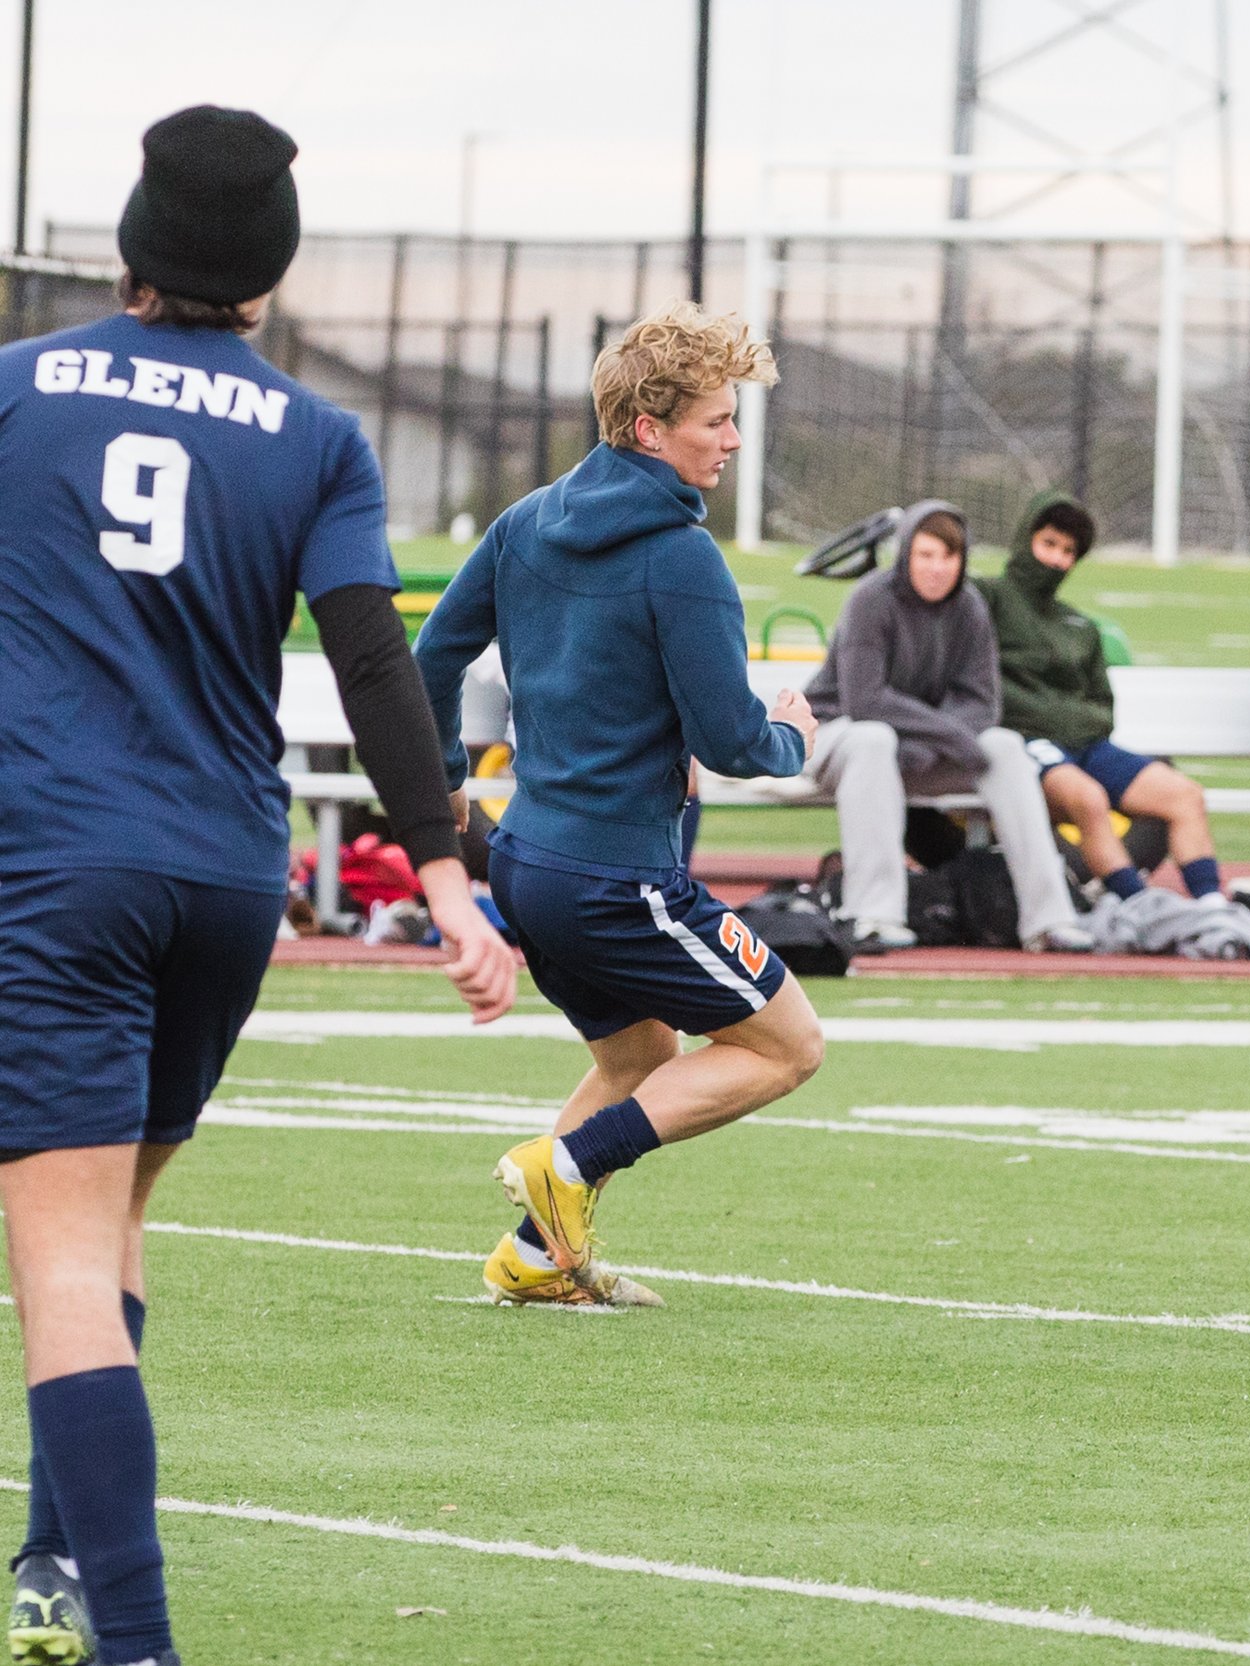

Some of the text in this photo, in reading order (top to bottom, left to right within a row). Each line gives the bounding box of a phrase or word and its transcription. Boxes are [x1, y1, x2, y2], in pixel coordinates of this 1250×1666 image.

[34, 348, 290, 434] GLENN
[99, 431, 192, 577] 9
[718, 911, 770, 981] 2
